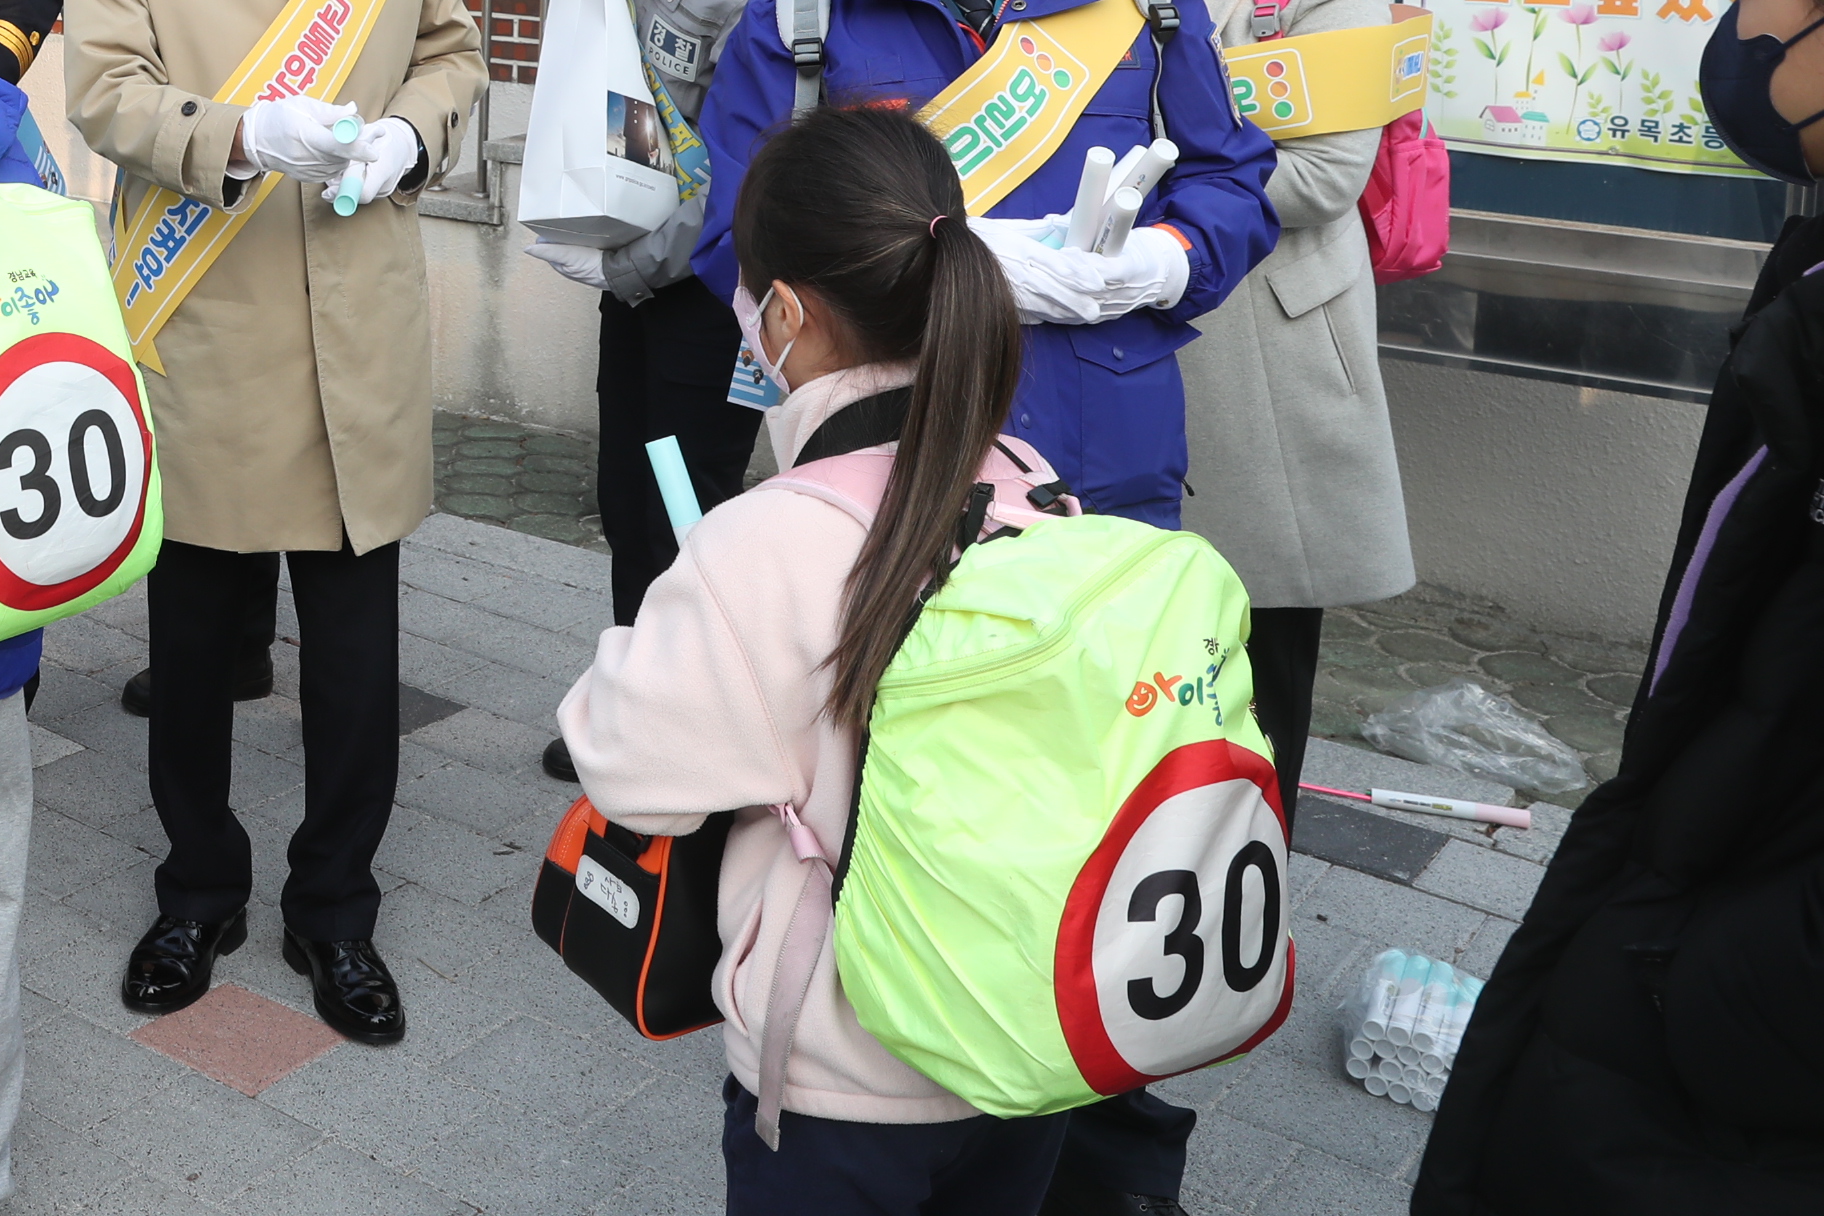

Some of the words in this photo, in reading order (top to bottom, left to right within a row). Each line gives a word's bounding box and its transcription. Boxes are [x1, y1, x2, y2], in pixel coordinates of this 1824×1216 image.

[648, 47, 690, 76] POLICE
[653, 22, 693, 62] 경찰
[942, 68, 1047, 176] 어린이
[8, 268, 37, 283] 경남교육
[1127, 840, 1280, 1020] 30
